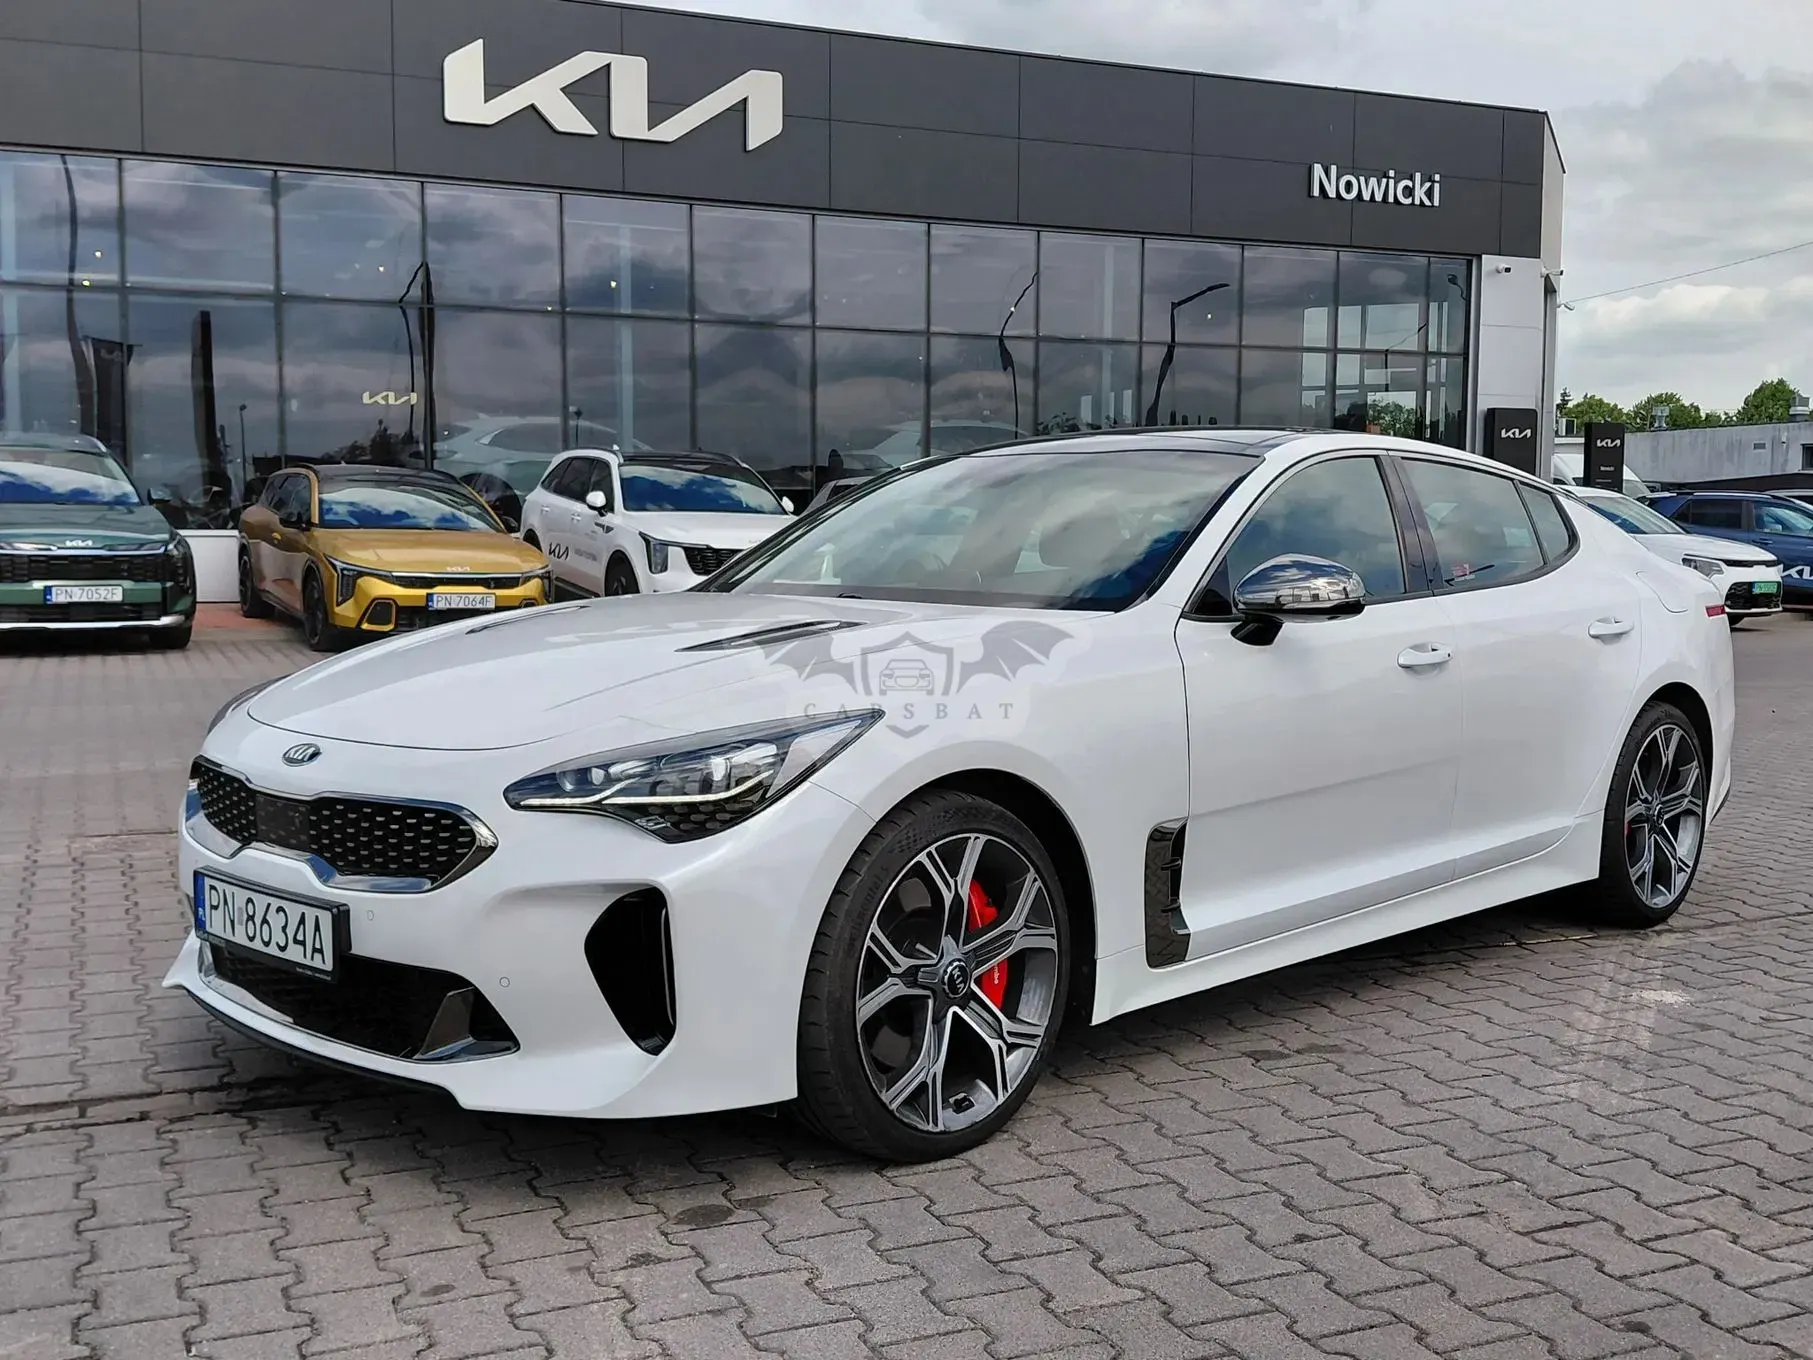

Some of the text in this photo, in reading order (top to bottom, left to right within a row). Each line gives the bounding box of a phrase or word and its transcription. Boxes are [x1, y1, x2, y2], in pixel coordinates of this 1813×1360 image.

[443, 38, 783, 152] KIA
[1309, 162, 1441, 207] Nowicki
[362, 391, 418, 405] KIA
[1501, 428, 1531, 439] KIA
[1596, 438, 1621, 447] KIA
[548, 542, 569, 560] KIA
[55, 588, 118, 600] PN 7052F
[436, 595, 492, 607] PN 7064F
[208, 884, 326, 965] PN 8634A
